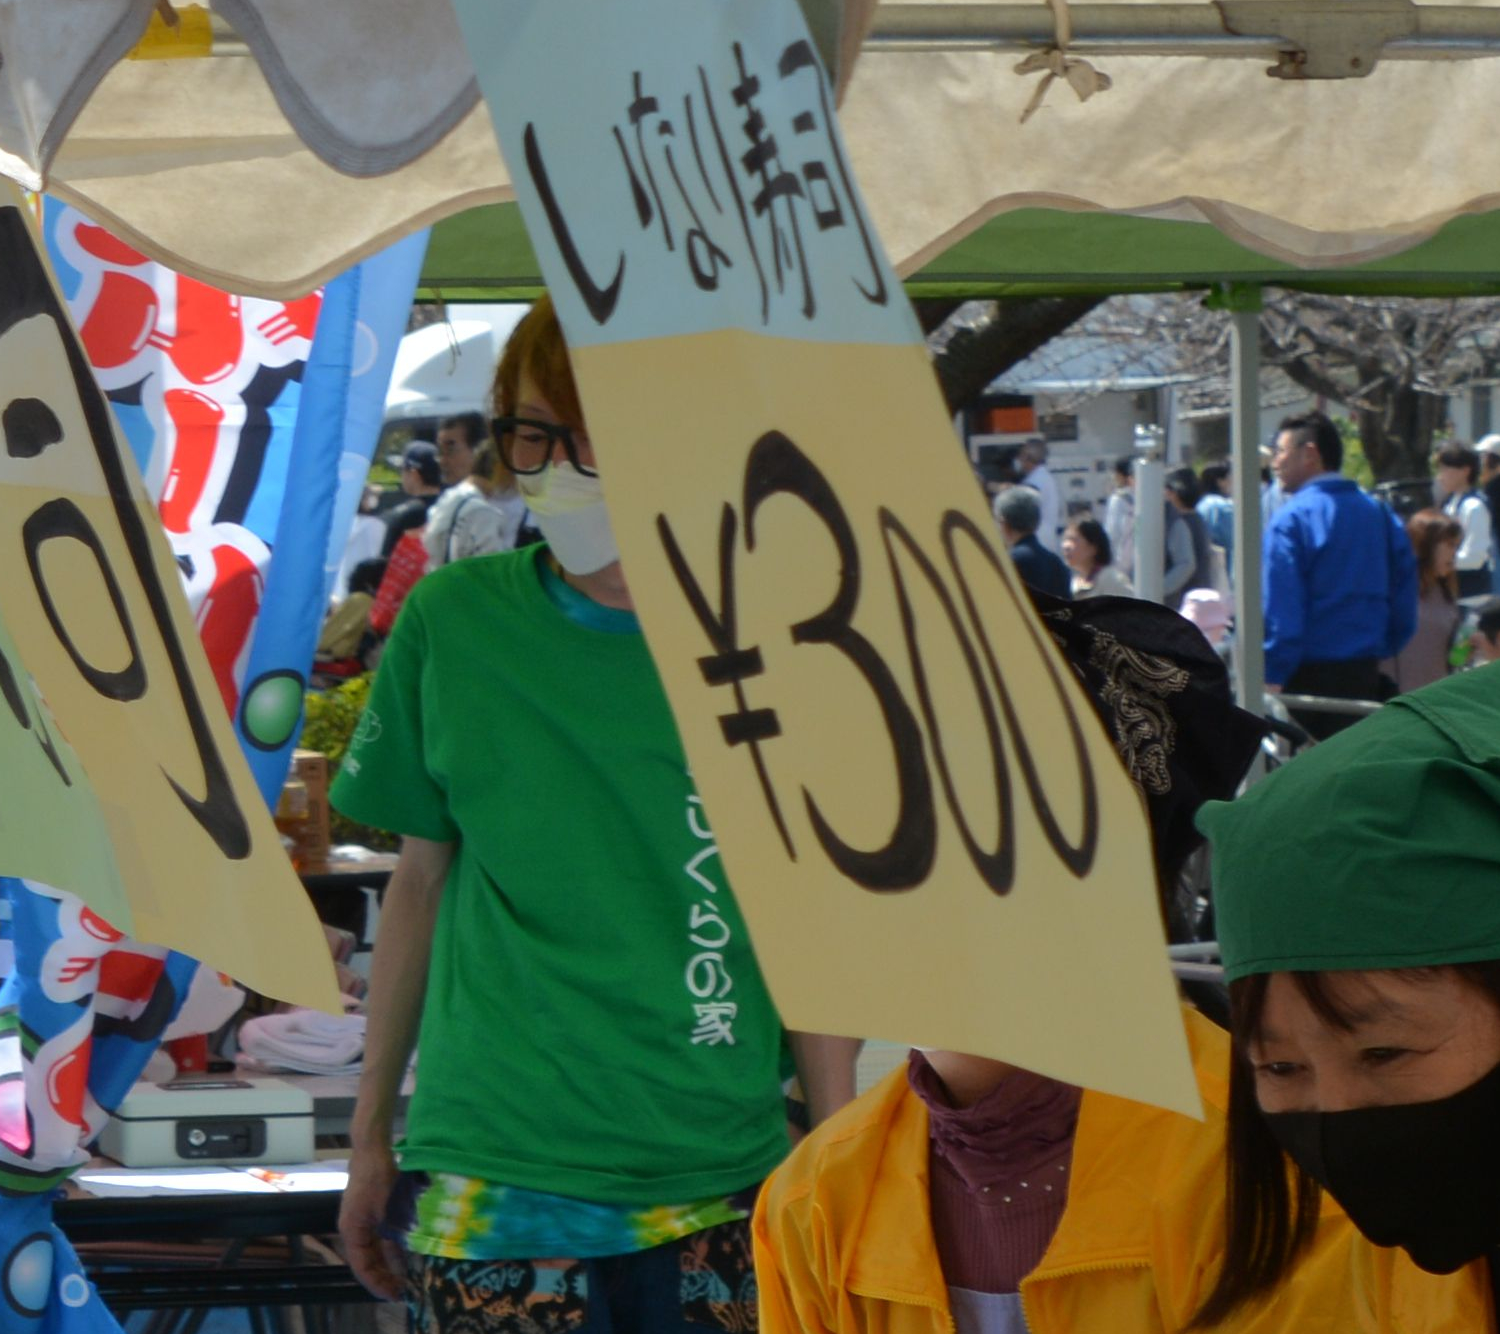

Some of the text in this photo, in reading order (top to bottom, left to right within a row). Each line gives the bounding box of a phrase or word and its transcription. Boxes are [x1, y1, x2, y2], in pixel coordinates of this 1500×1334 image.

[523, 38, 889, 327] いなり寿司
[656, 428, 1101, 897] ¥300
